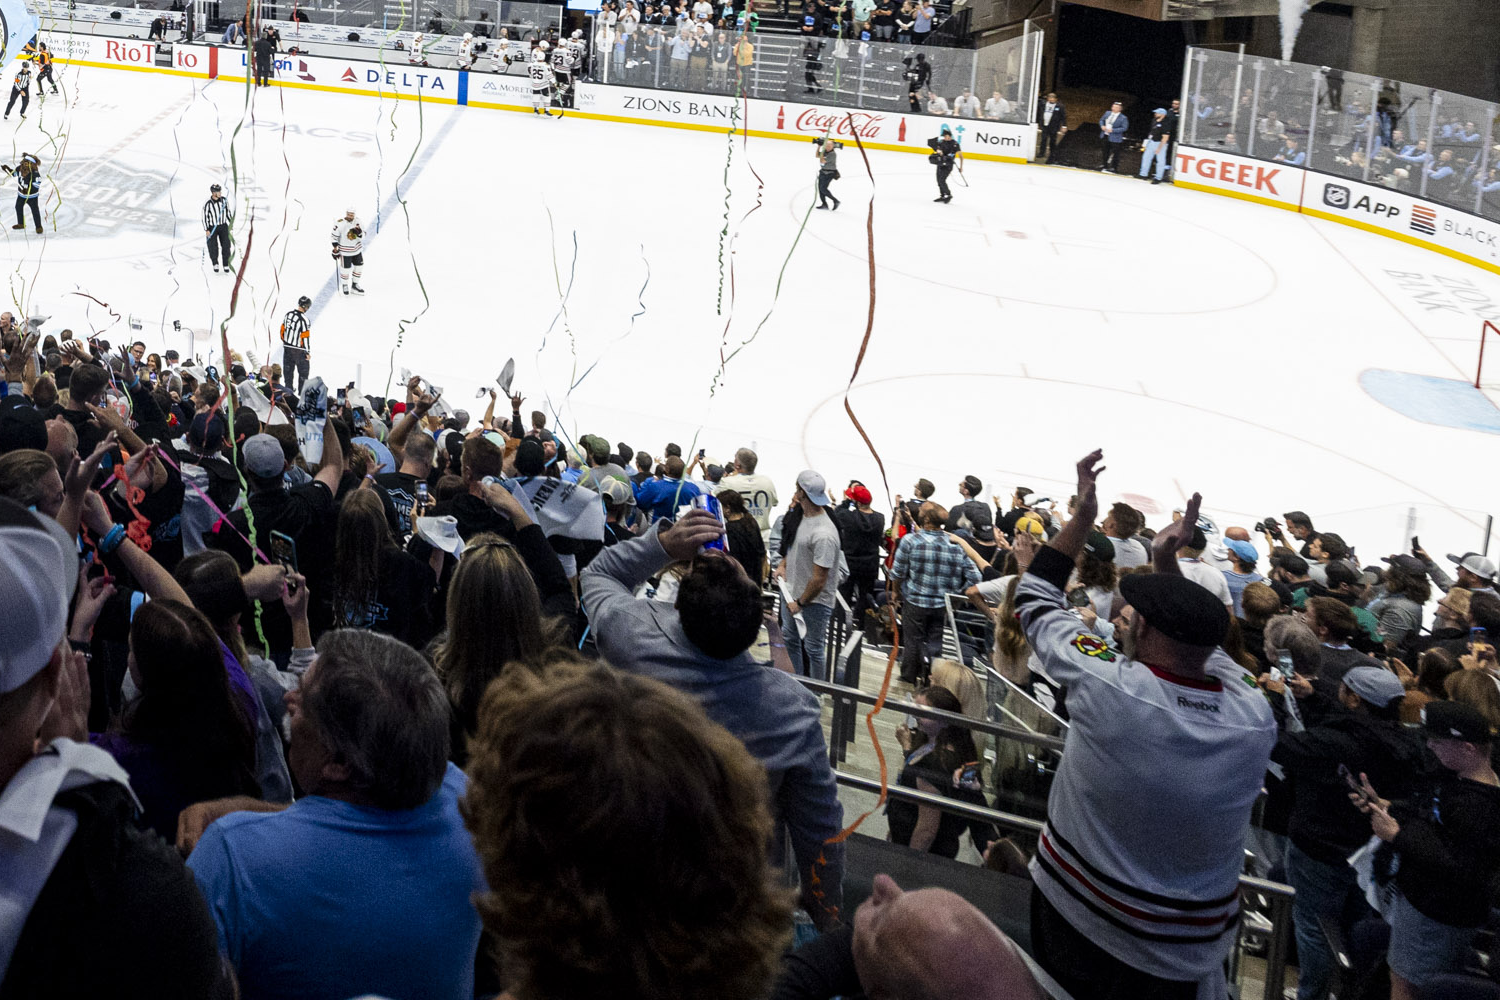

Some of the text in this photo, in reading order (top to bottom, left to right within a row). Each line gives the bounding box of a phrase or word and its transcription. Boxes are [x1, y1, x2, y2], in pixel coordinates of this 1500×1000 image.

[66, 39, 92, 49] SPORTS
[366, 68, 445, 91] DELTA
[531, 68, 544, 81] 25
[623, 95, 743, 121] ZIONS BANK
[795, 106, 888, 139] Coca-Cola
[975, 131, 1022, 148] Nomi
[1352, 194, 1401, 219] APP
[1443, 218, 1498, 248] BLACK
